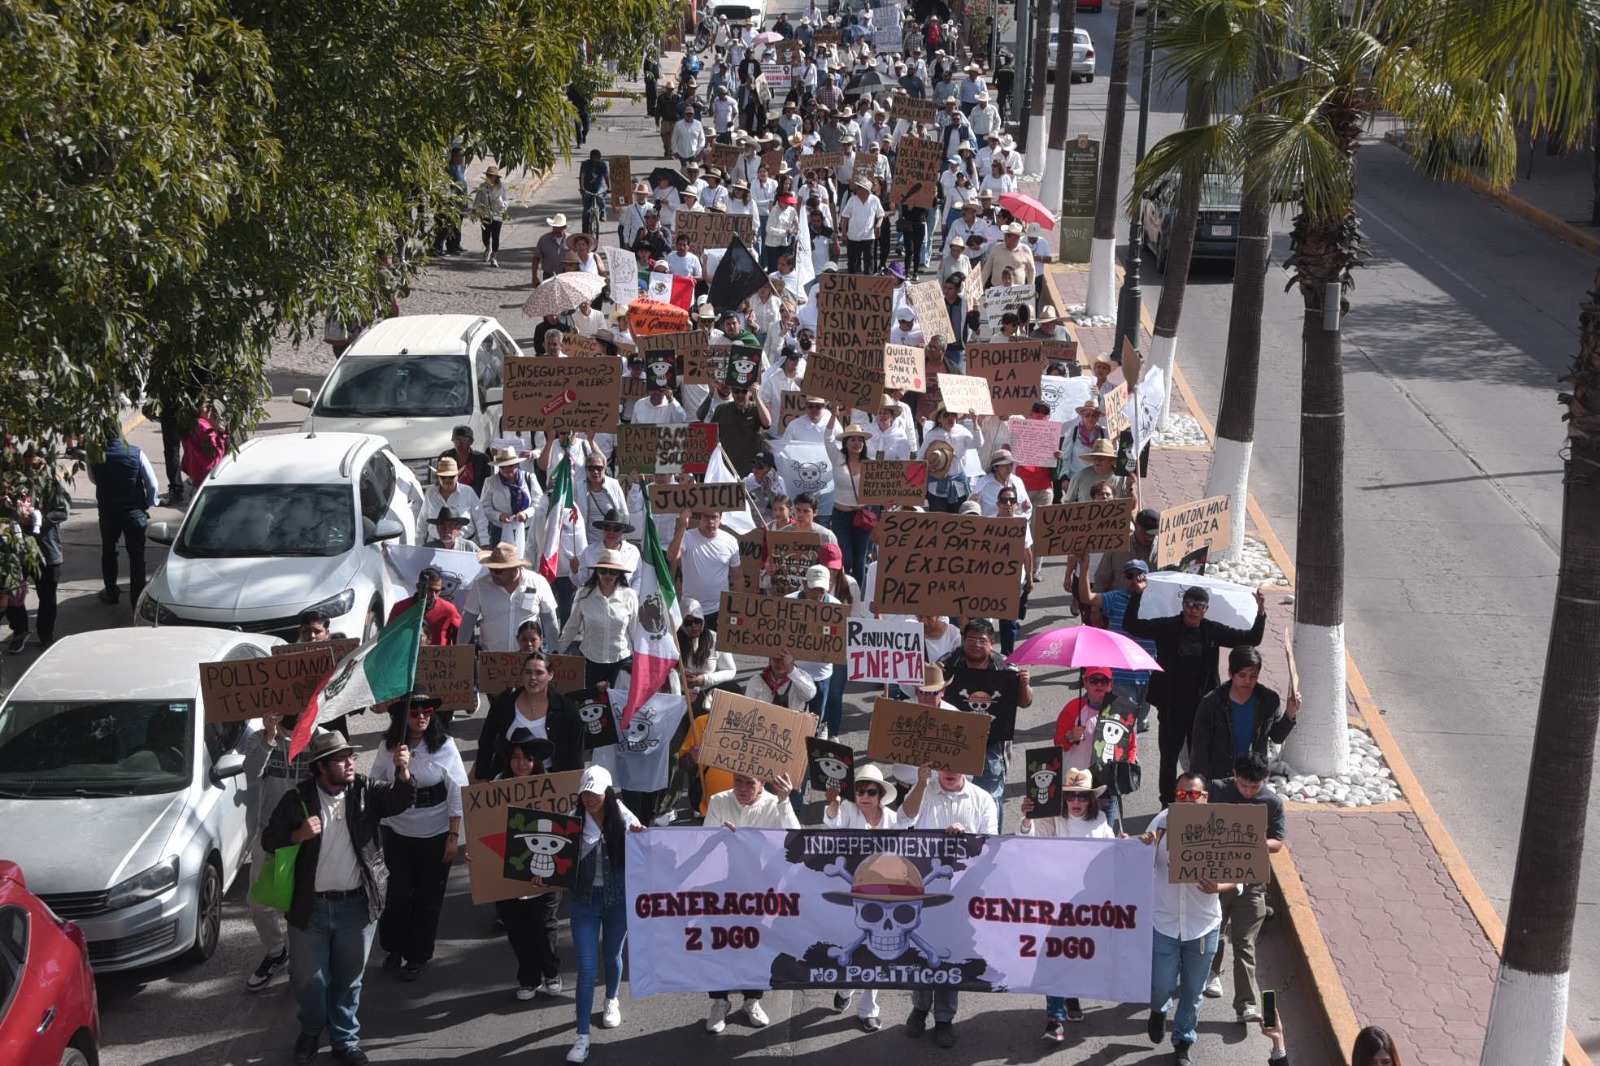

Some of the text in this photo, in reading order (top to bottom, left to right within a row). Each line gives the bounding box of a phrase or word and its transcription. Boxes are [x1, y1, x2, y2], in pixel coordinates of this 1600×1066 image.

[678, 213, 701, 229] SOY
[824, 275, 857, 291] SIN
[822, 292, 891, 313] TRABAJO
[810, 354, 853, 378] TODOS
[994, 369, 1016, 382] LA
[810, 373, 872, 397] MANZO
[992, 385, 1038, 400] RANIA
[625, 426, 672, 443] PATRIA
[625, 442, 642, 453] EN
[646, 440, 681, 453] CADA
[655, 484, 746, 509] JUSTICIA
[1042, 502, 1126, 526] UNIDOS
[1159, 518, 1171, 534] LA
[1206, 497, 1230, 517] HACE
[884, 514, 1026, 538] SOMOS HIJOS
[1046, 521, 1092, 537] SOMOS
[1166, 518, 1219, 547] LA FUERZA
[884, 533, 1010, 556] DE LA PATRIA
[1049, 533, 1125, 553] FUERTES
[884, 552, 1019, 577] Y EXIGIMOS
[881, 578, 966, 605] PAZ PARA
[726, 595, 843, 624] LUCHEMOS
[952, 596, 1008, 615] TODOS
[757, 617, 808, 634] POR UN
[847, 621, 922, 652] RENUNCIA
[785, 634, 844, 653] SEGURO
[207, 662, 270, 690] POLIS
[216, 694, 246, 713] TE
[718, 736, 790, 764] GOBIERNO
[891, 736, 961, 756] GOBIERNO
[910, 749, 931, 758] DE
[712, 754, 774, 778] MIERDA
[743, 752, 760, 765] DE
[469, 791, 481, 812] X
[803, 835, 969, 859] INDEPENDIENTES
[1181, 849, 1252, 862] GOBIERNO
[1177, 866, 1257, 880] MIERDA
[1207, 860, 1225, 868] DE
[635, 888, 801, 919] GENERACIÓN
[967, 895, 1138, 929] GENERACIÓN
[684, 925, 761, 951] Z DGO
[1019, 934, 1096, 960] Z DGO
